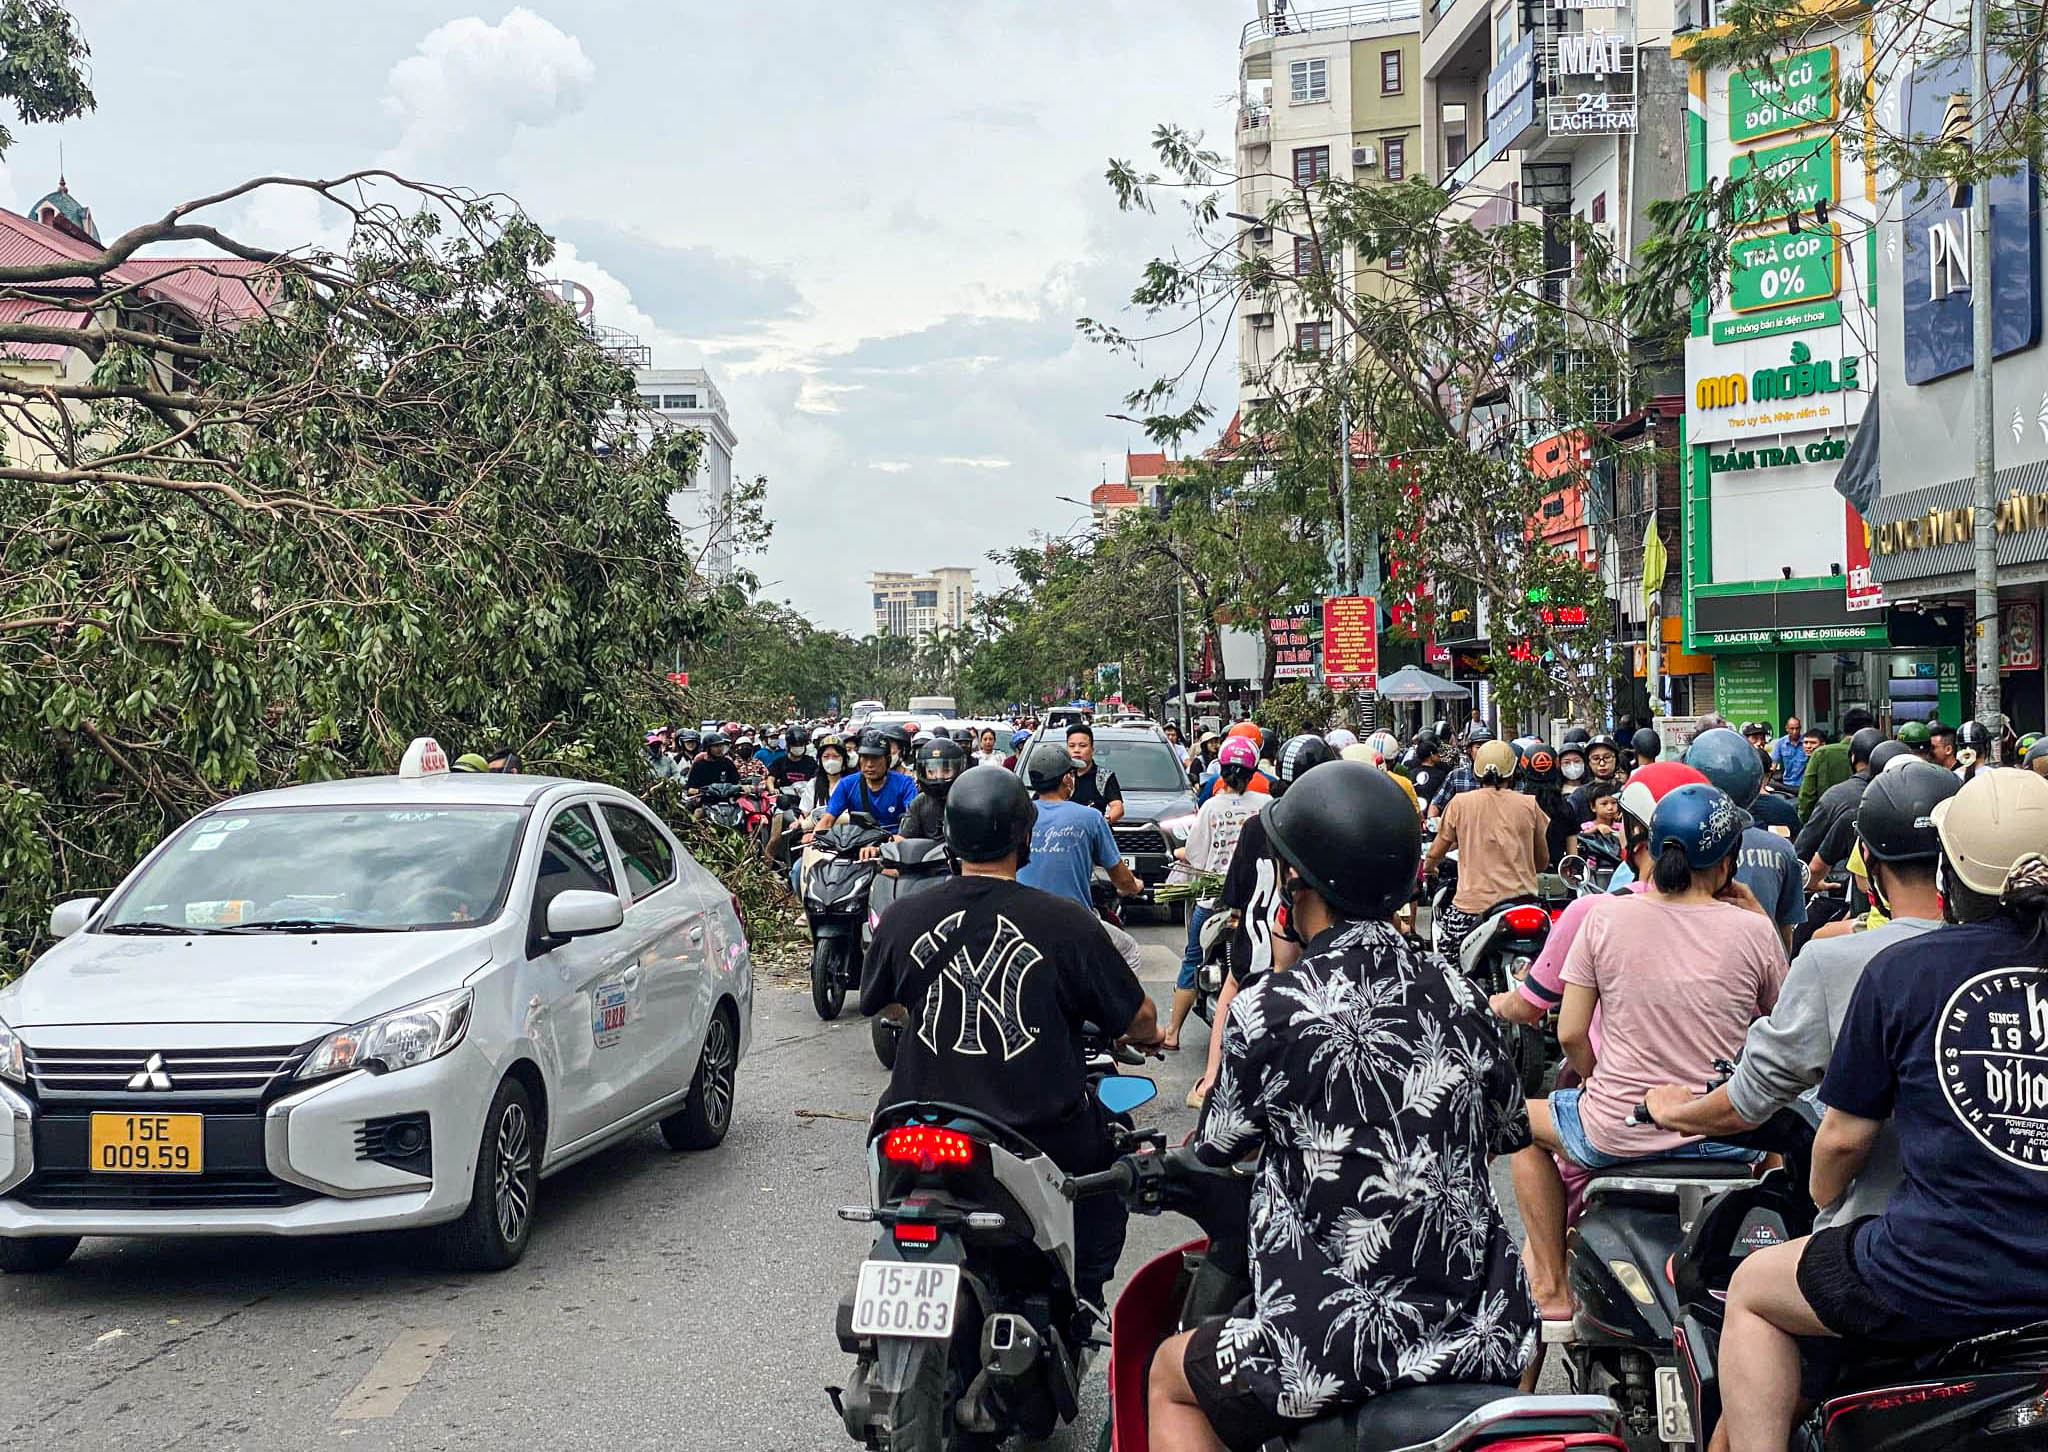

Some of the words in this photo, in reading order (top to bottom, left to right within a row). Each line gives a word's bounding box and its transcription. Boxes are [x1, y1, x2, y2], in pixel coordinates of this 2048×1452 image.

[1557, 26, 1624, 81] MẶT
[1788, 61, 1813, 88] CŨ
[1576, 92, 1609, 112] 24
[1597, 112, 1637, 130] TRAY
[1743, 240, 1779, 268] TRẢ
[1783, 235, 1821, 261] GÓP
[1760, 264, 1805, 299] 0%
[1711, 447, 1755, 474] BÁN
[1713, 634, 1724, 643] 20
[1749, 631, 1770, 642] TRAY
[1780, 629, 1818, 641] HOTLINE:
[1940, 663, 1956, 677] 20
[1948, 1007, 1969, 1033] IN
[1969, 975, 2022, 1004] LIFE
[1988, 1011, 2020, 1025] SINCE
[126, 1117, 169, 1141] 15E
[2005, 1118, 2046, 1130] POWERFUL
[103, 1144, 190, 1169] 009.59
[877, 1267, 944, 1299] 15-AP
[859, 1298, 949, 1331] 060.63
